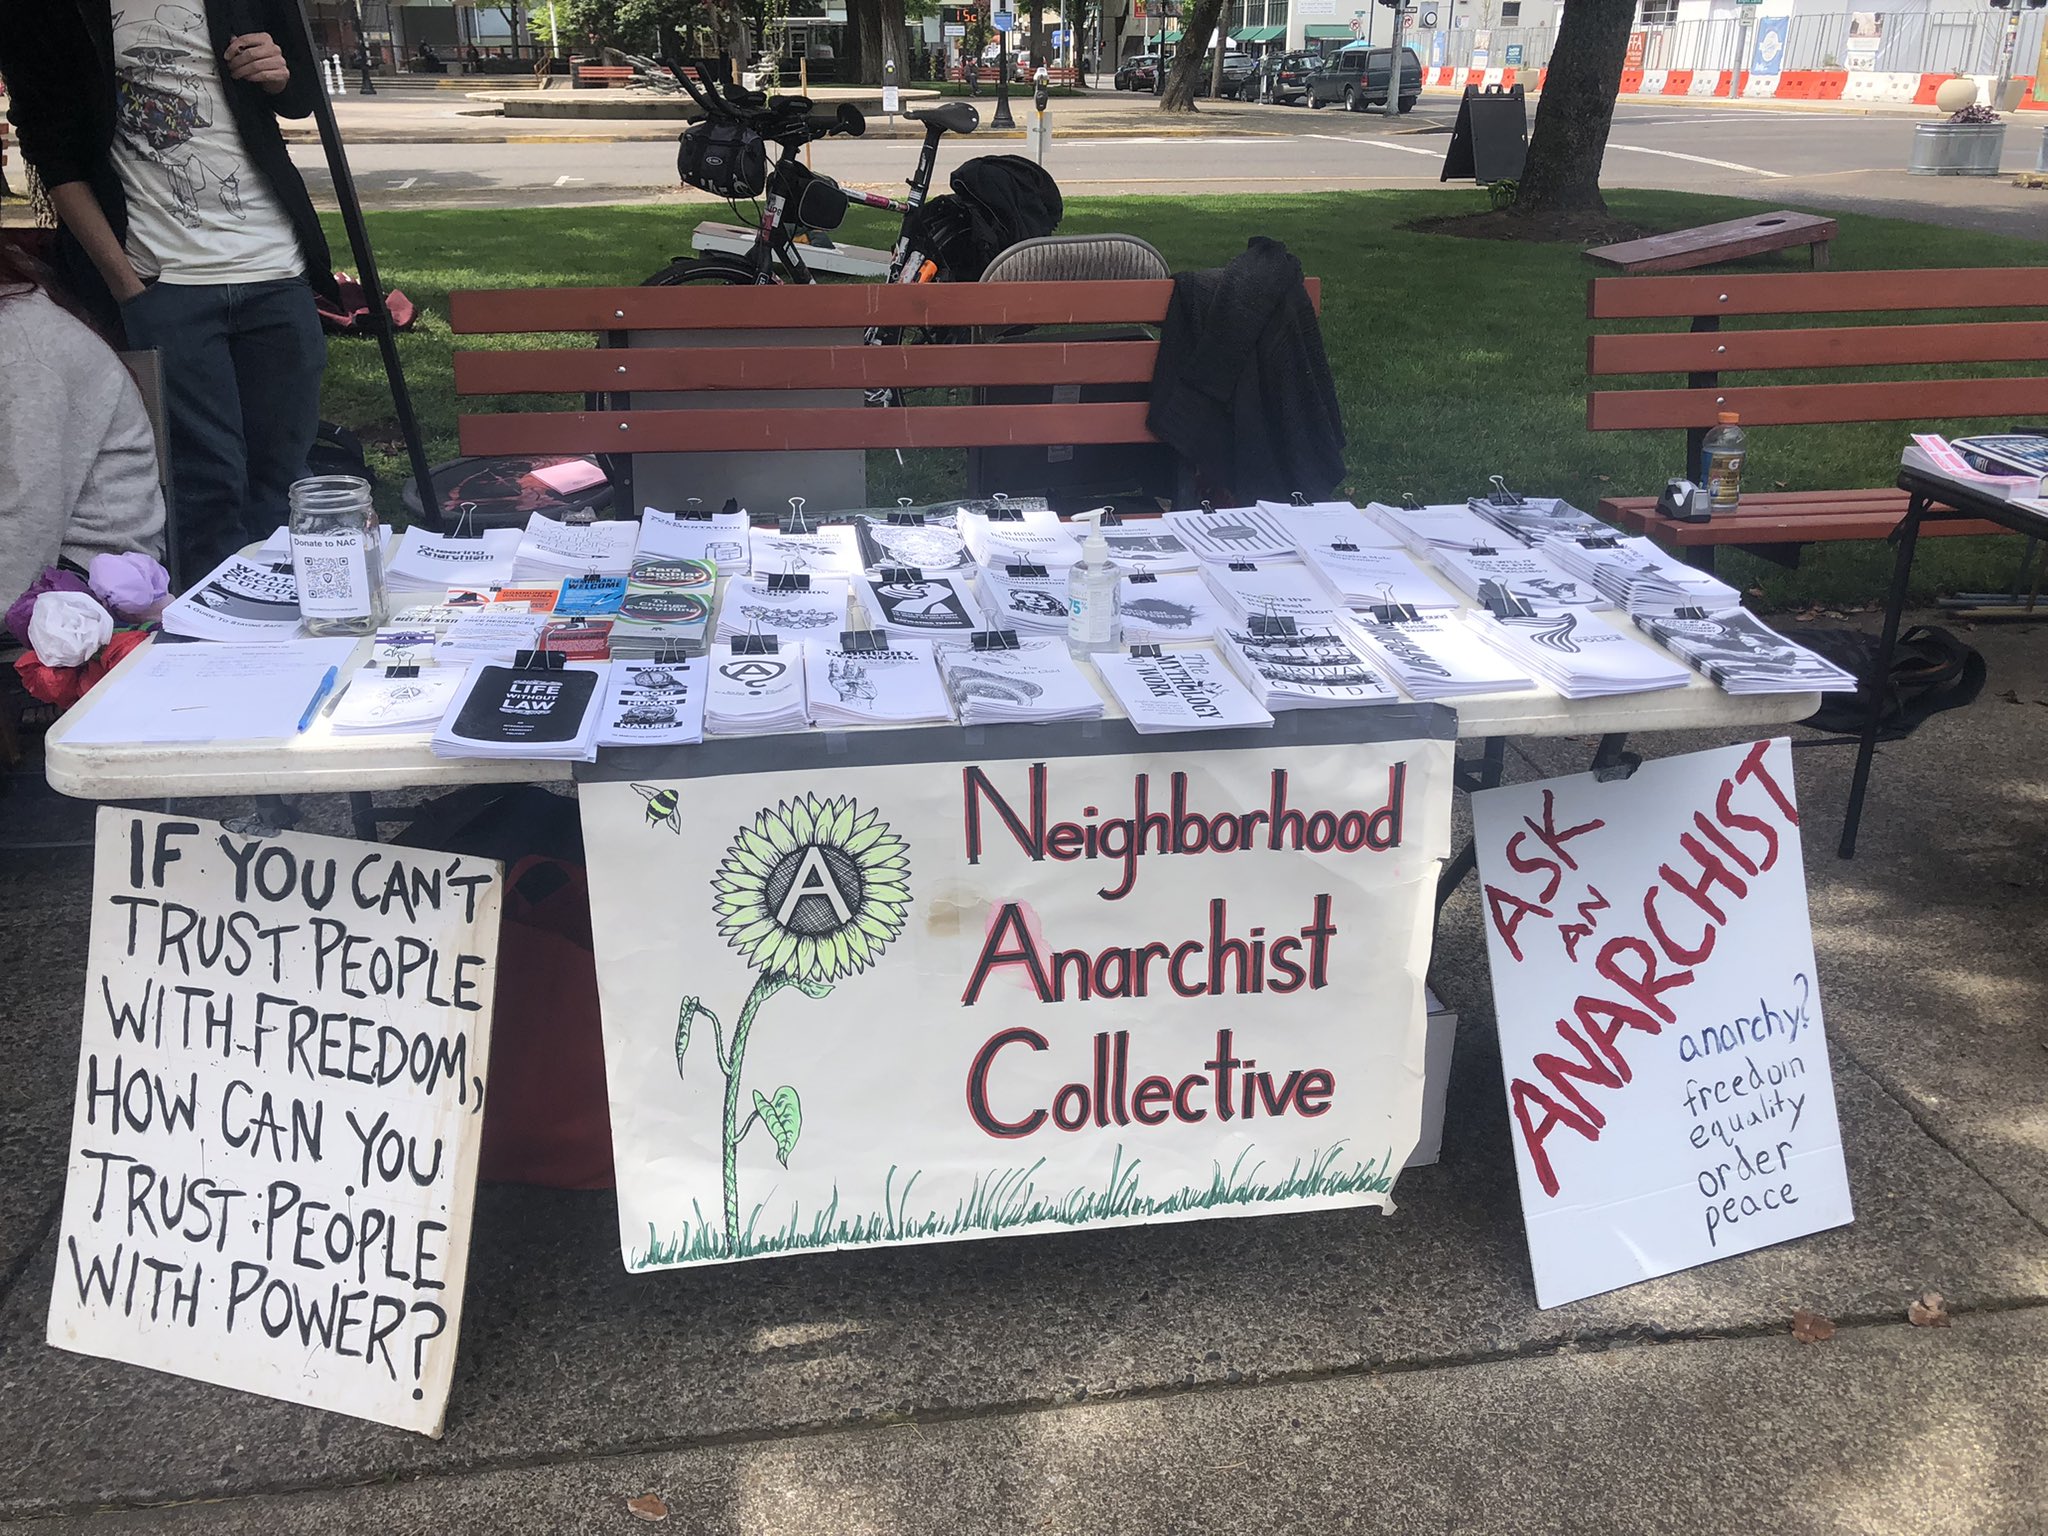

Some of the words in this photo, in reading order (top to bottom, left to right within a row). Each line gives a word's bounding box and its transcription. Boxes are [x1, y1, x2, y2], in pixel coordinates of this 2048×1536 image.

[236, 562, 294, 582] WHAT
[294, 538, 322, 548] Donate
[336, 538, 356, 547] NAC
[416, 549, 494, 561] Anarchism
[419, 544, 485, 555] Queering
[567, 582, 621, 590] WELCOME
[625, 604, 698, 613] Everything
[639, 601, 687, 609] Change
[1256, 660, 1367, 676] SURVIVAL
[1574, 634, 1626, 643] POLICE
[502, 699, 556, 710] LAW
[506, 692, 559, 701] WITHOUT
[509, 683, 561, 695] LIFE
[1136, 668, 1178, 698] WORK
[1155, 654, 1224, 719] MYTHOLOGY
[1271, 679, 1393, 697] GUIDE
[961, 760, 1406, 901] Neighborhood
[129, 818, 200, 889] IF
[217, 833, 337, 911] YOU
[351, 853, 494, 924] CAN'T
[1484, 788, 1606, 963] ASK
[109, 895, 300, 984] TRUST
[309, 916, 487, 1012] PEOPLE
[961, 892, 1338, 1007] Anarchist
[1557, 883, 1611, 963] AN
[1510, 739, 1800, 1199] ANARCHIST
[102, 974, 233, 1057] WITH
[255, 992, 484, 1114] FREEDOM,
[1678, 972, 1811, 1063] anarchy?
[965, 1026, 1336, 1140] Collective
[1682, 1055, 1806, 1117] freedom
[88, 1053, 198, 1135] HOW
[221, 1079, 323, 1163] CAN
[346, 1110, 443, 1188] YOU
[1689, 1088, 1806, 1149] equality
[1697, 1139, 1793, 1199] order
[80, 1148, 247, 1253] TRUST
[267, 1180, 446, 1290] PEOPLE
[1705, 1182, 1800, 1247] peace
[68, 1234, 202, 1328] WITH
[226, 1261, 448, 1401] POWER?
